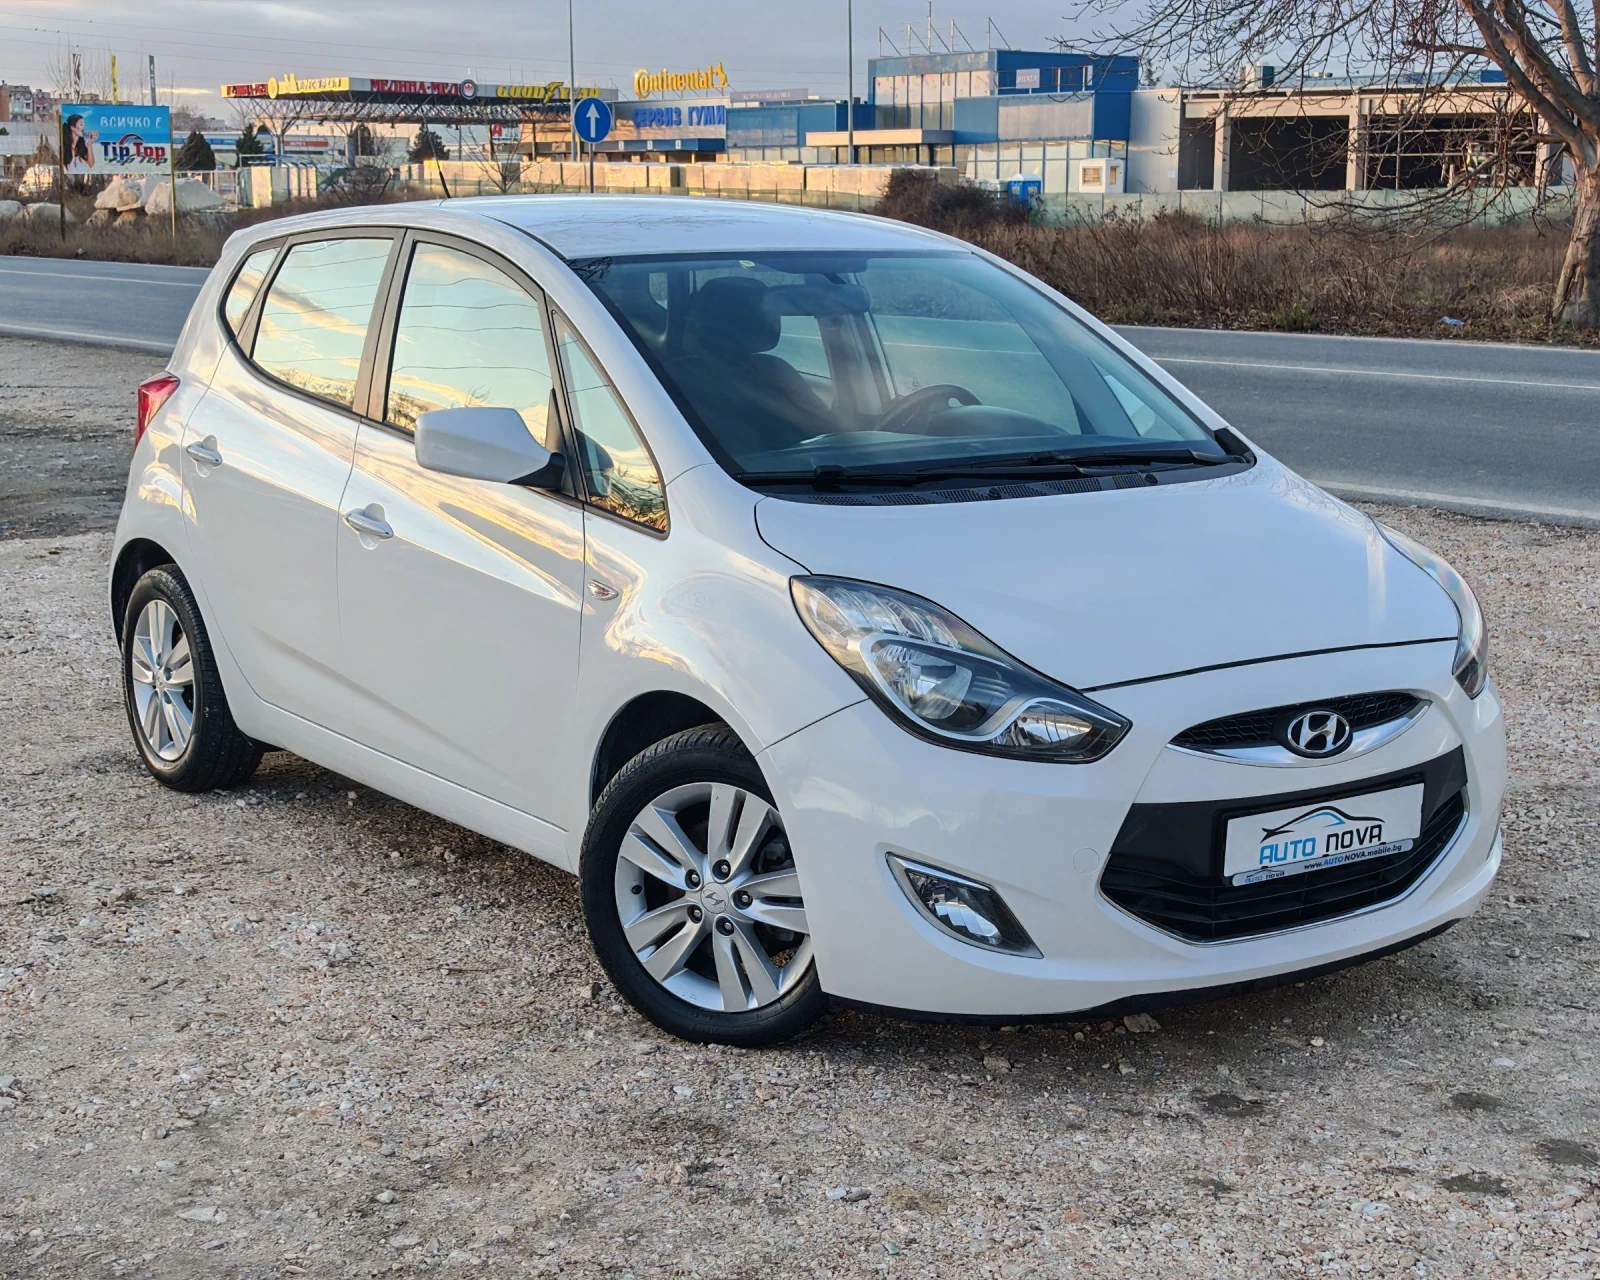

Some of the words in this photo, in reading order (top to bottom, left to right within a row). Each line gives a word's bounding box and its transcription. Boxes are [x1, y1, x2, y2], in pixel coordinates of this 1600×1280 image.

[634, 65, 713, 99] Continental
[100, 116, 150, 128] ВСИЧКО
[632, 107, 682, 128] СЕРВИЗ
[688, 105, 725, 126] ГУМИ
[100, 142, 130, 162] Tip
[133, 142, 165, 162] Top
[1259, 837, 1316, 865] AUTO
[1325, 824, 1382, 853] NOVA
